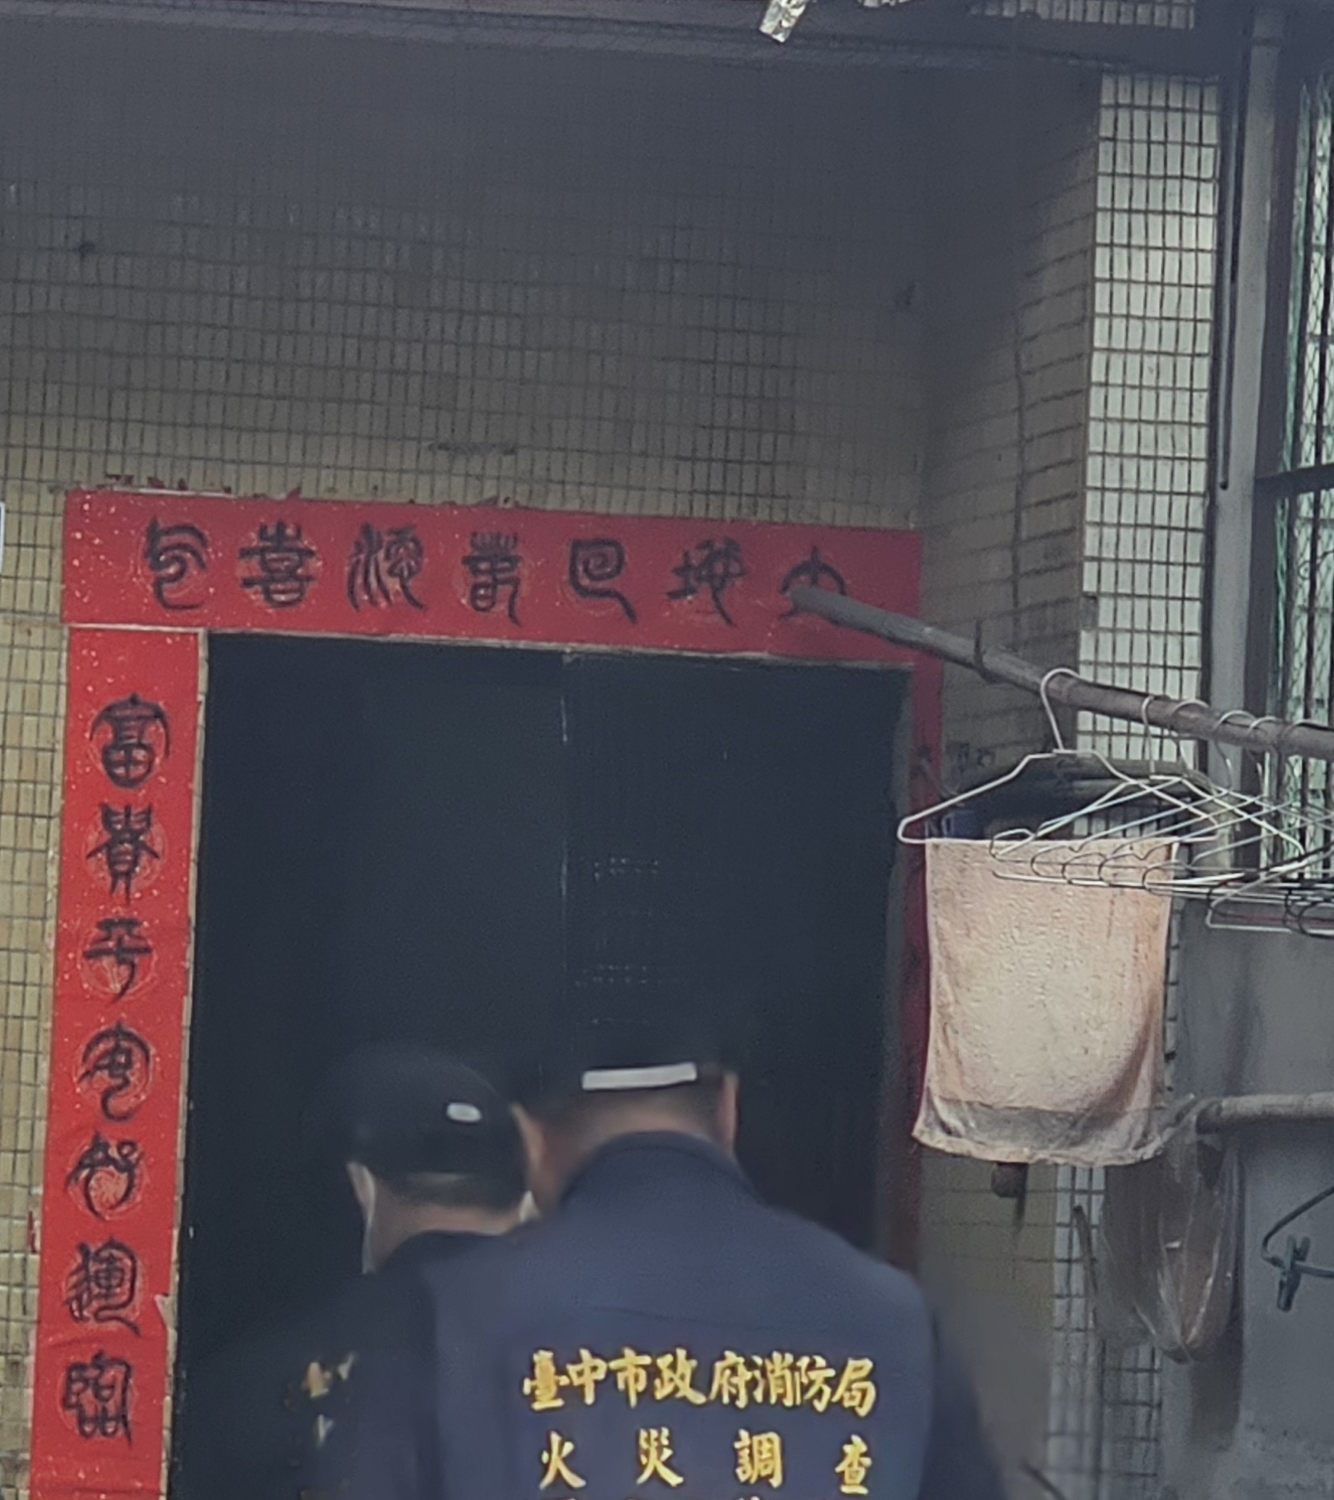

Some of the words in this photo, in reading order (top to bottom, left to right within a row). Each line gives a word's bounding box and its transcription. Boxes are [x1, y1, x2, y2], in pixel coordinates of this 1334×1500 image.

[523, 1347, 878, 1417] 臺中市政府消防局
[539, 1427, 873, 1495] 火災調查
